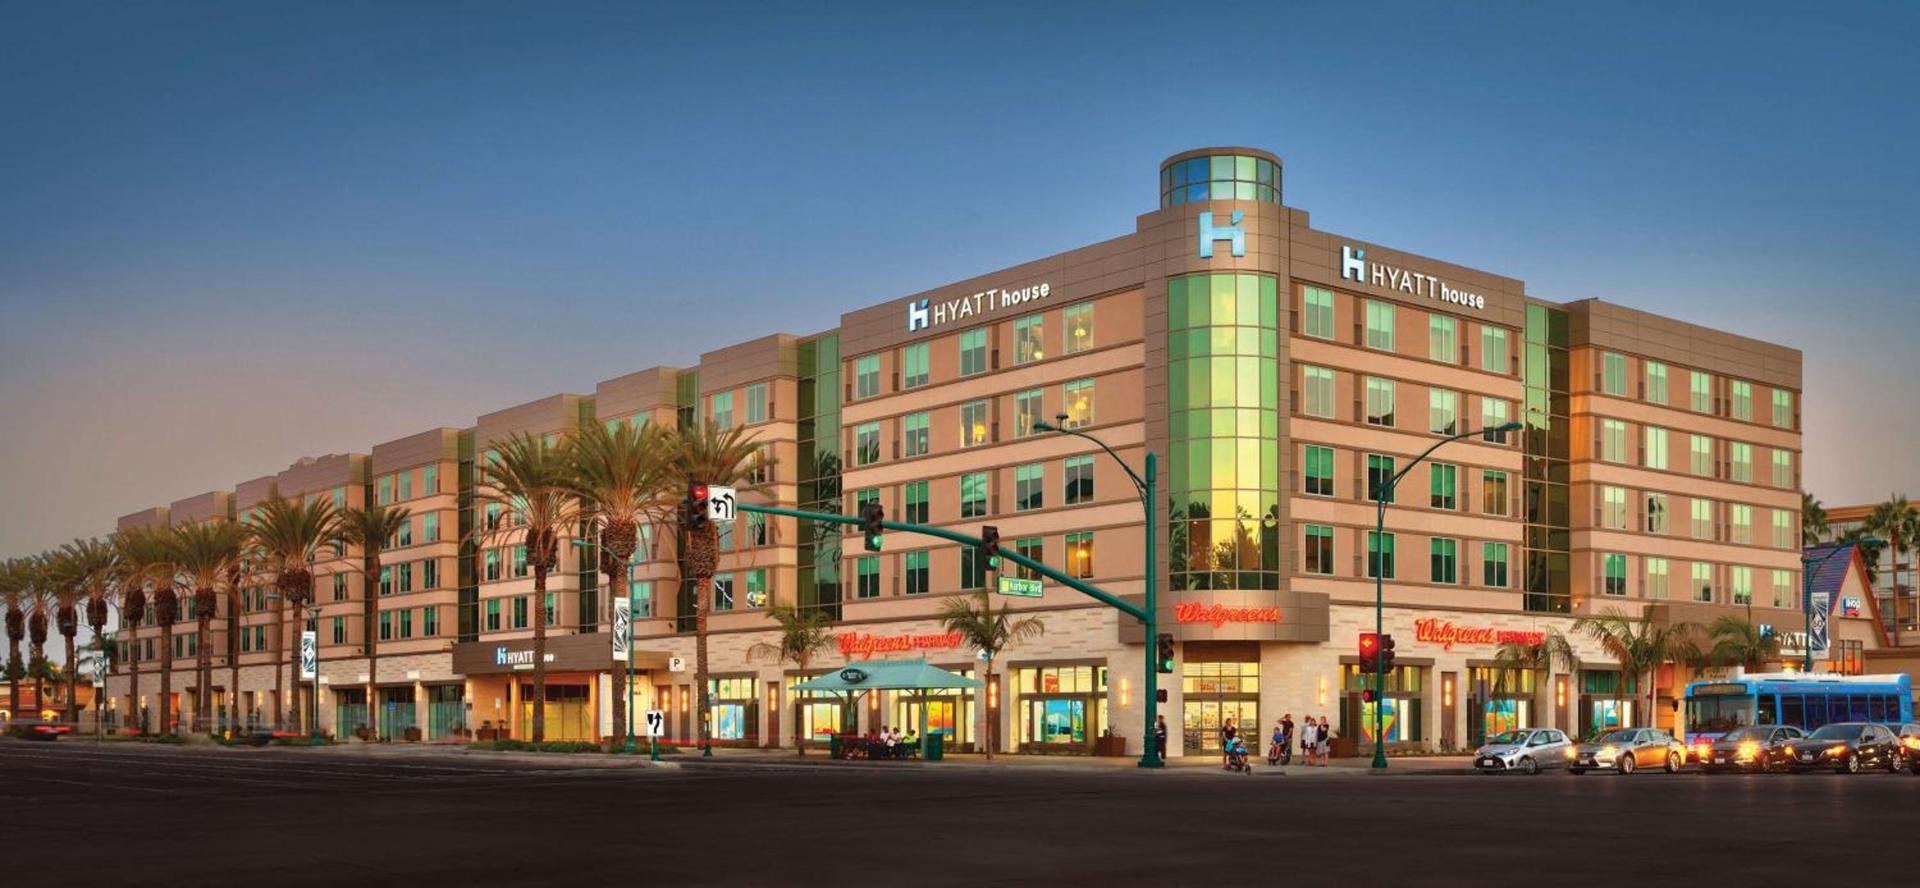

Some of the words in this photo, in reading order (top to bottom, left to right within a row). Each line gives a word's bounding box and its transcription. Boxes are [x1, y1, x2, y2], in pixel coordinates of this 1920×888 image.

[1371, 263, 1438, 298] HYATT
[1441, 282, 1484, 309] house
[934, 289, 998, 325] HYATT
[1001, 283, 1050, 308] house
[1009, 581, 1028, 592] Harbor
[1030, 583, 1042, 593] Blvd
[1175, 602, 1281, 629] Walgreens
[838, 631, 913, 659] Walgreens
[1415, 617, 1495, 652] Walgreens
[507, 650, 534, 665] HYATT
[674, 659, 680, 667] P
